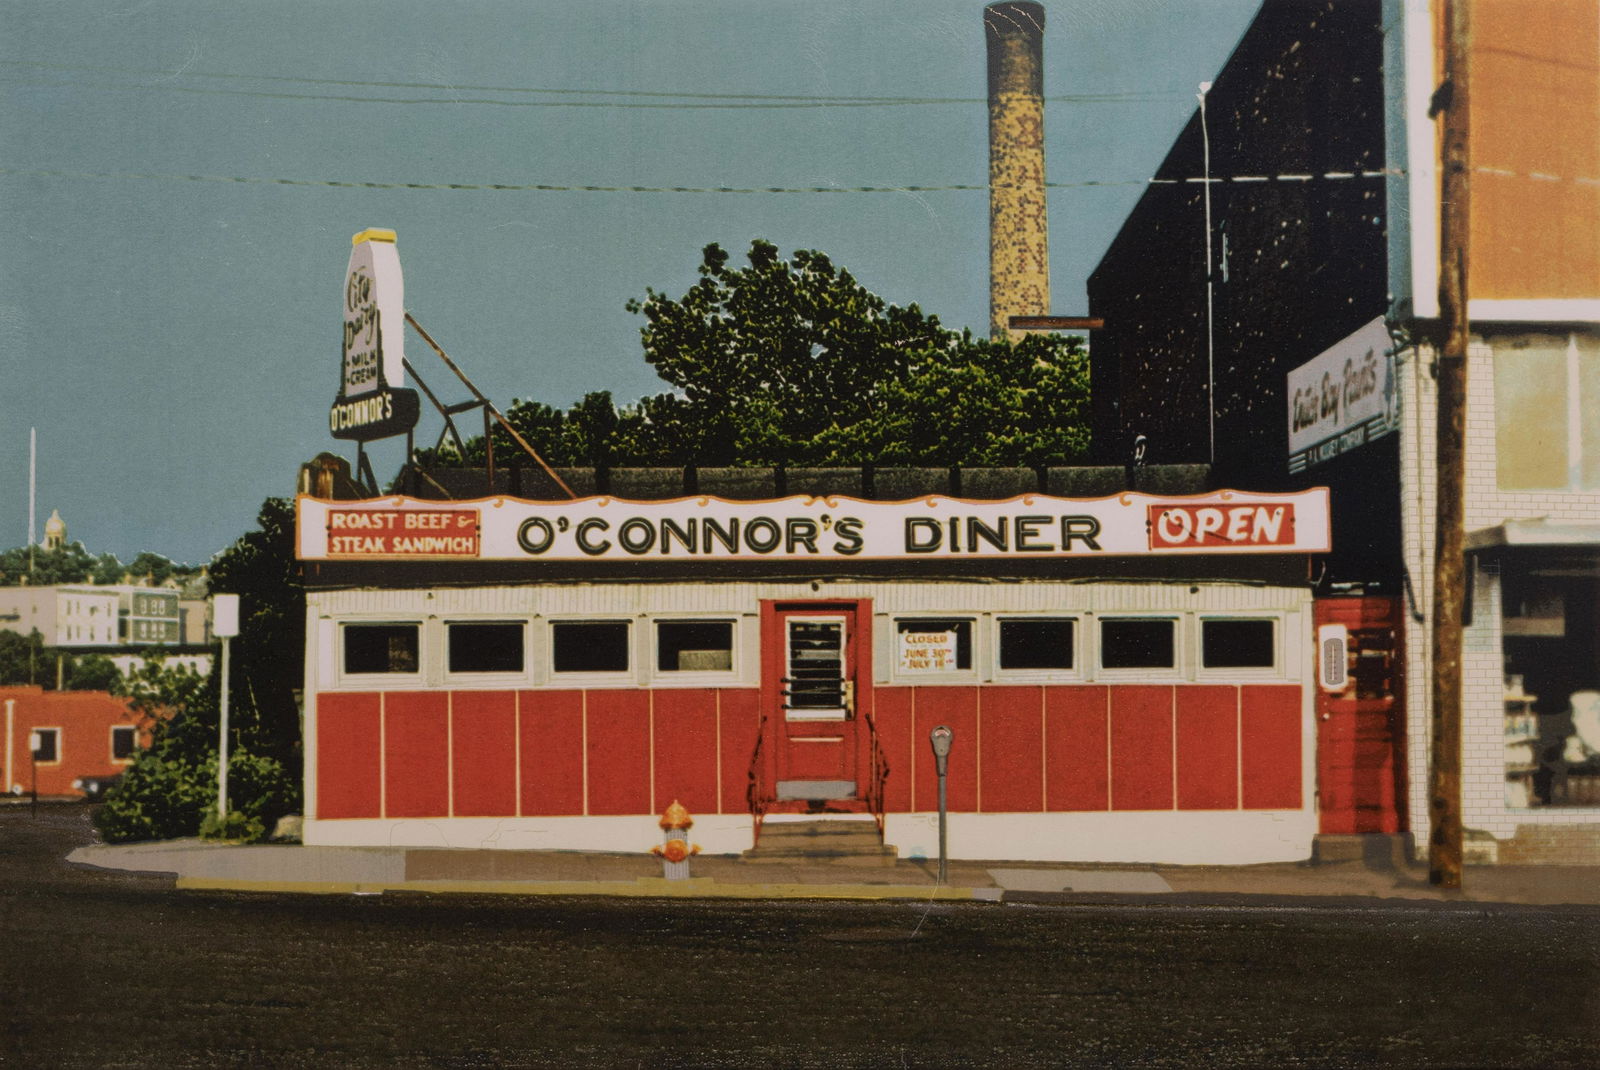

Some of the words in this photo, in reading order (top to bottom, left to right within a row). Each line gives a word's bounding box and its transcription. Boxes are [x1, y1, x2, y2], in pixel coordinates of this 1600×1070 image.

[351, 366, 376, 386] CREAM
[330, 392, 393, 432] O'CONNOR'S
[332, 513, 398, 529] ROAST
[405, 513, 453, 529] BEEF
[457, 515, 475, 528] &
[1157, 506, 1285, 544] OPEN
[516, 514, 866, 555] O'CONNOR'S
[904, 514, 1103, 554] DINER
[332, 536, 386, 553] STEAK
[393, 536, 474, 553] SANDWICH
[905, 634, 948, 644] CLOSED
[904, 648, 929, 659] JUNE
[908, 659, 930, 669] JULY
